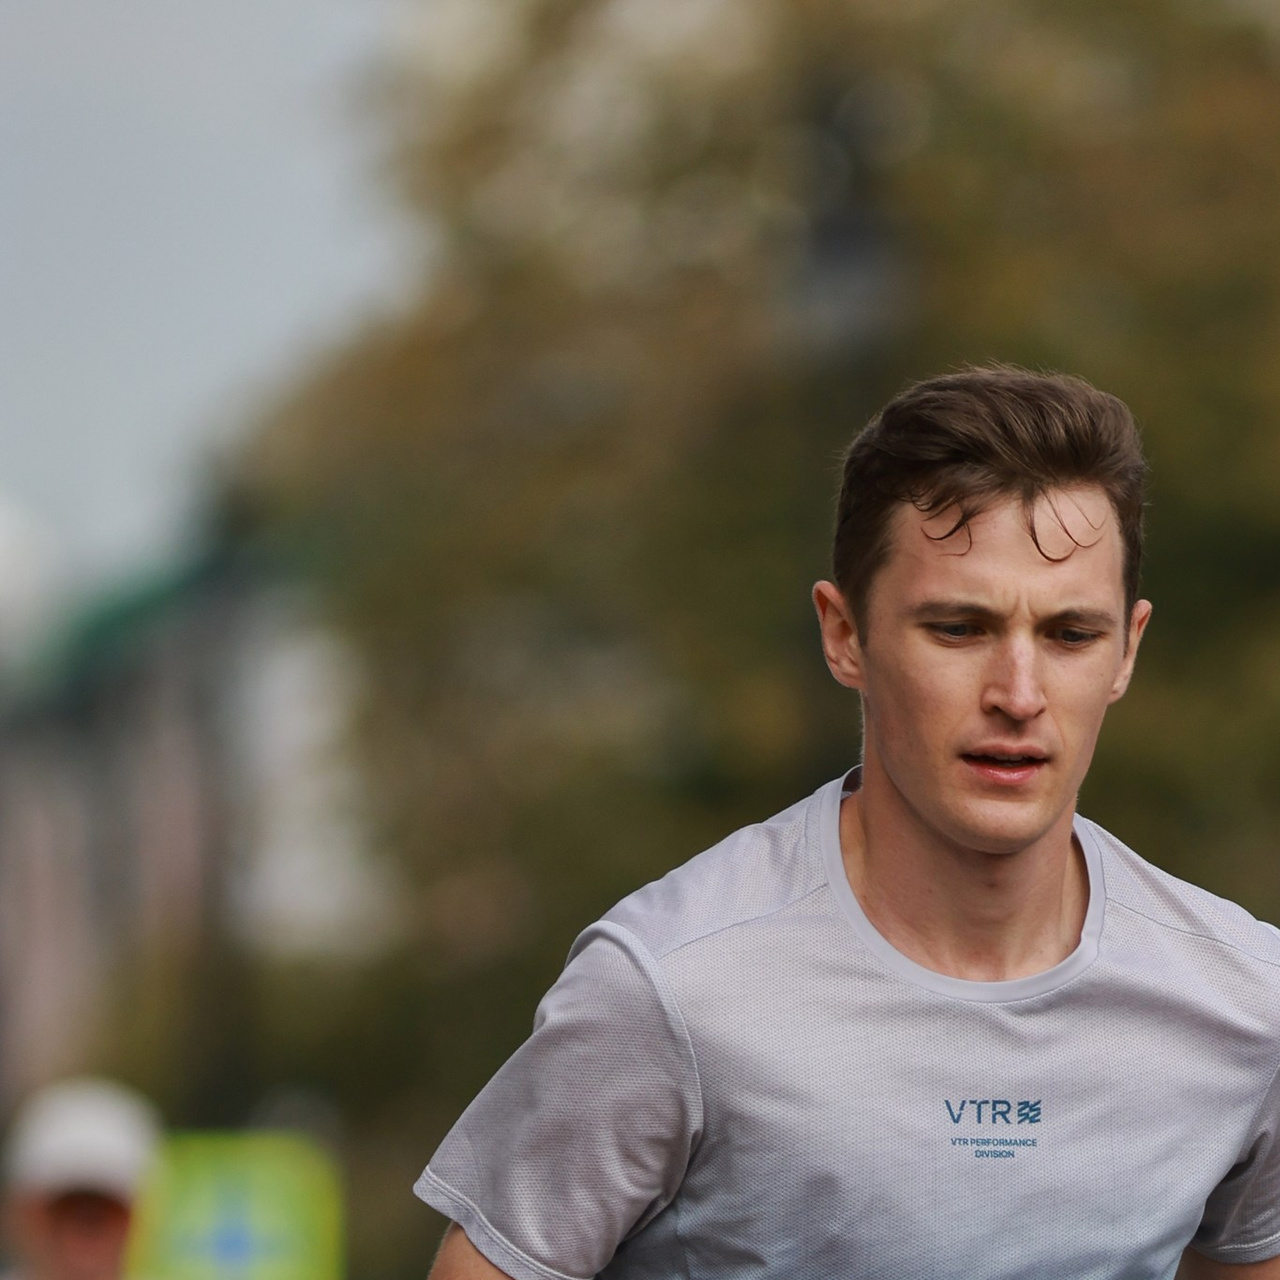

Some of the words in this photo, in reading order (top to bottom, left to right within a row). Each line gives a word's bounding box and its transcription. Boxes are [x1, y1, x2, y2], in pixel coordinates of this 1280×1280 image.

[944, 1099, 1012, 1124] VTR
[951, 1138, 969, 1146] VTR
[970, 1138, 1037, 1147] PERFORMANCE
[975, 1150, 1015, 1158] DIVISION
